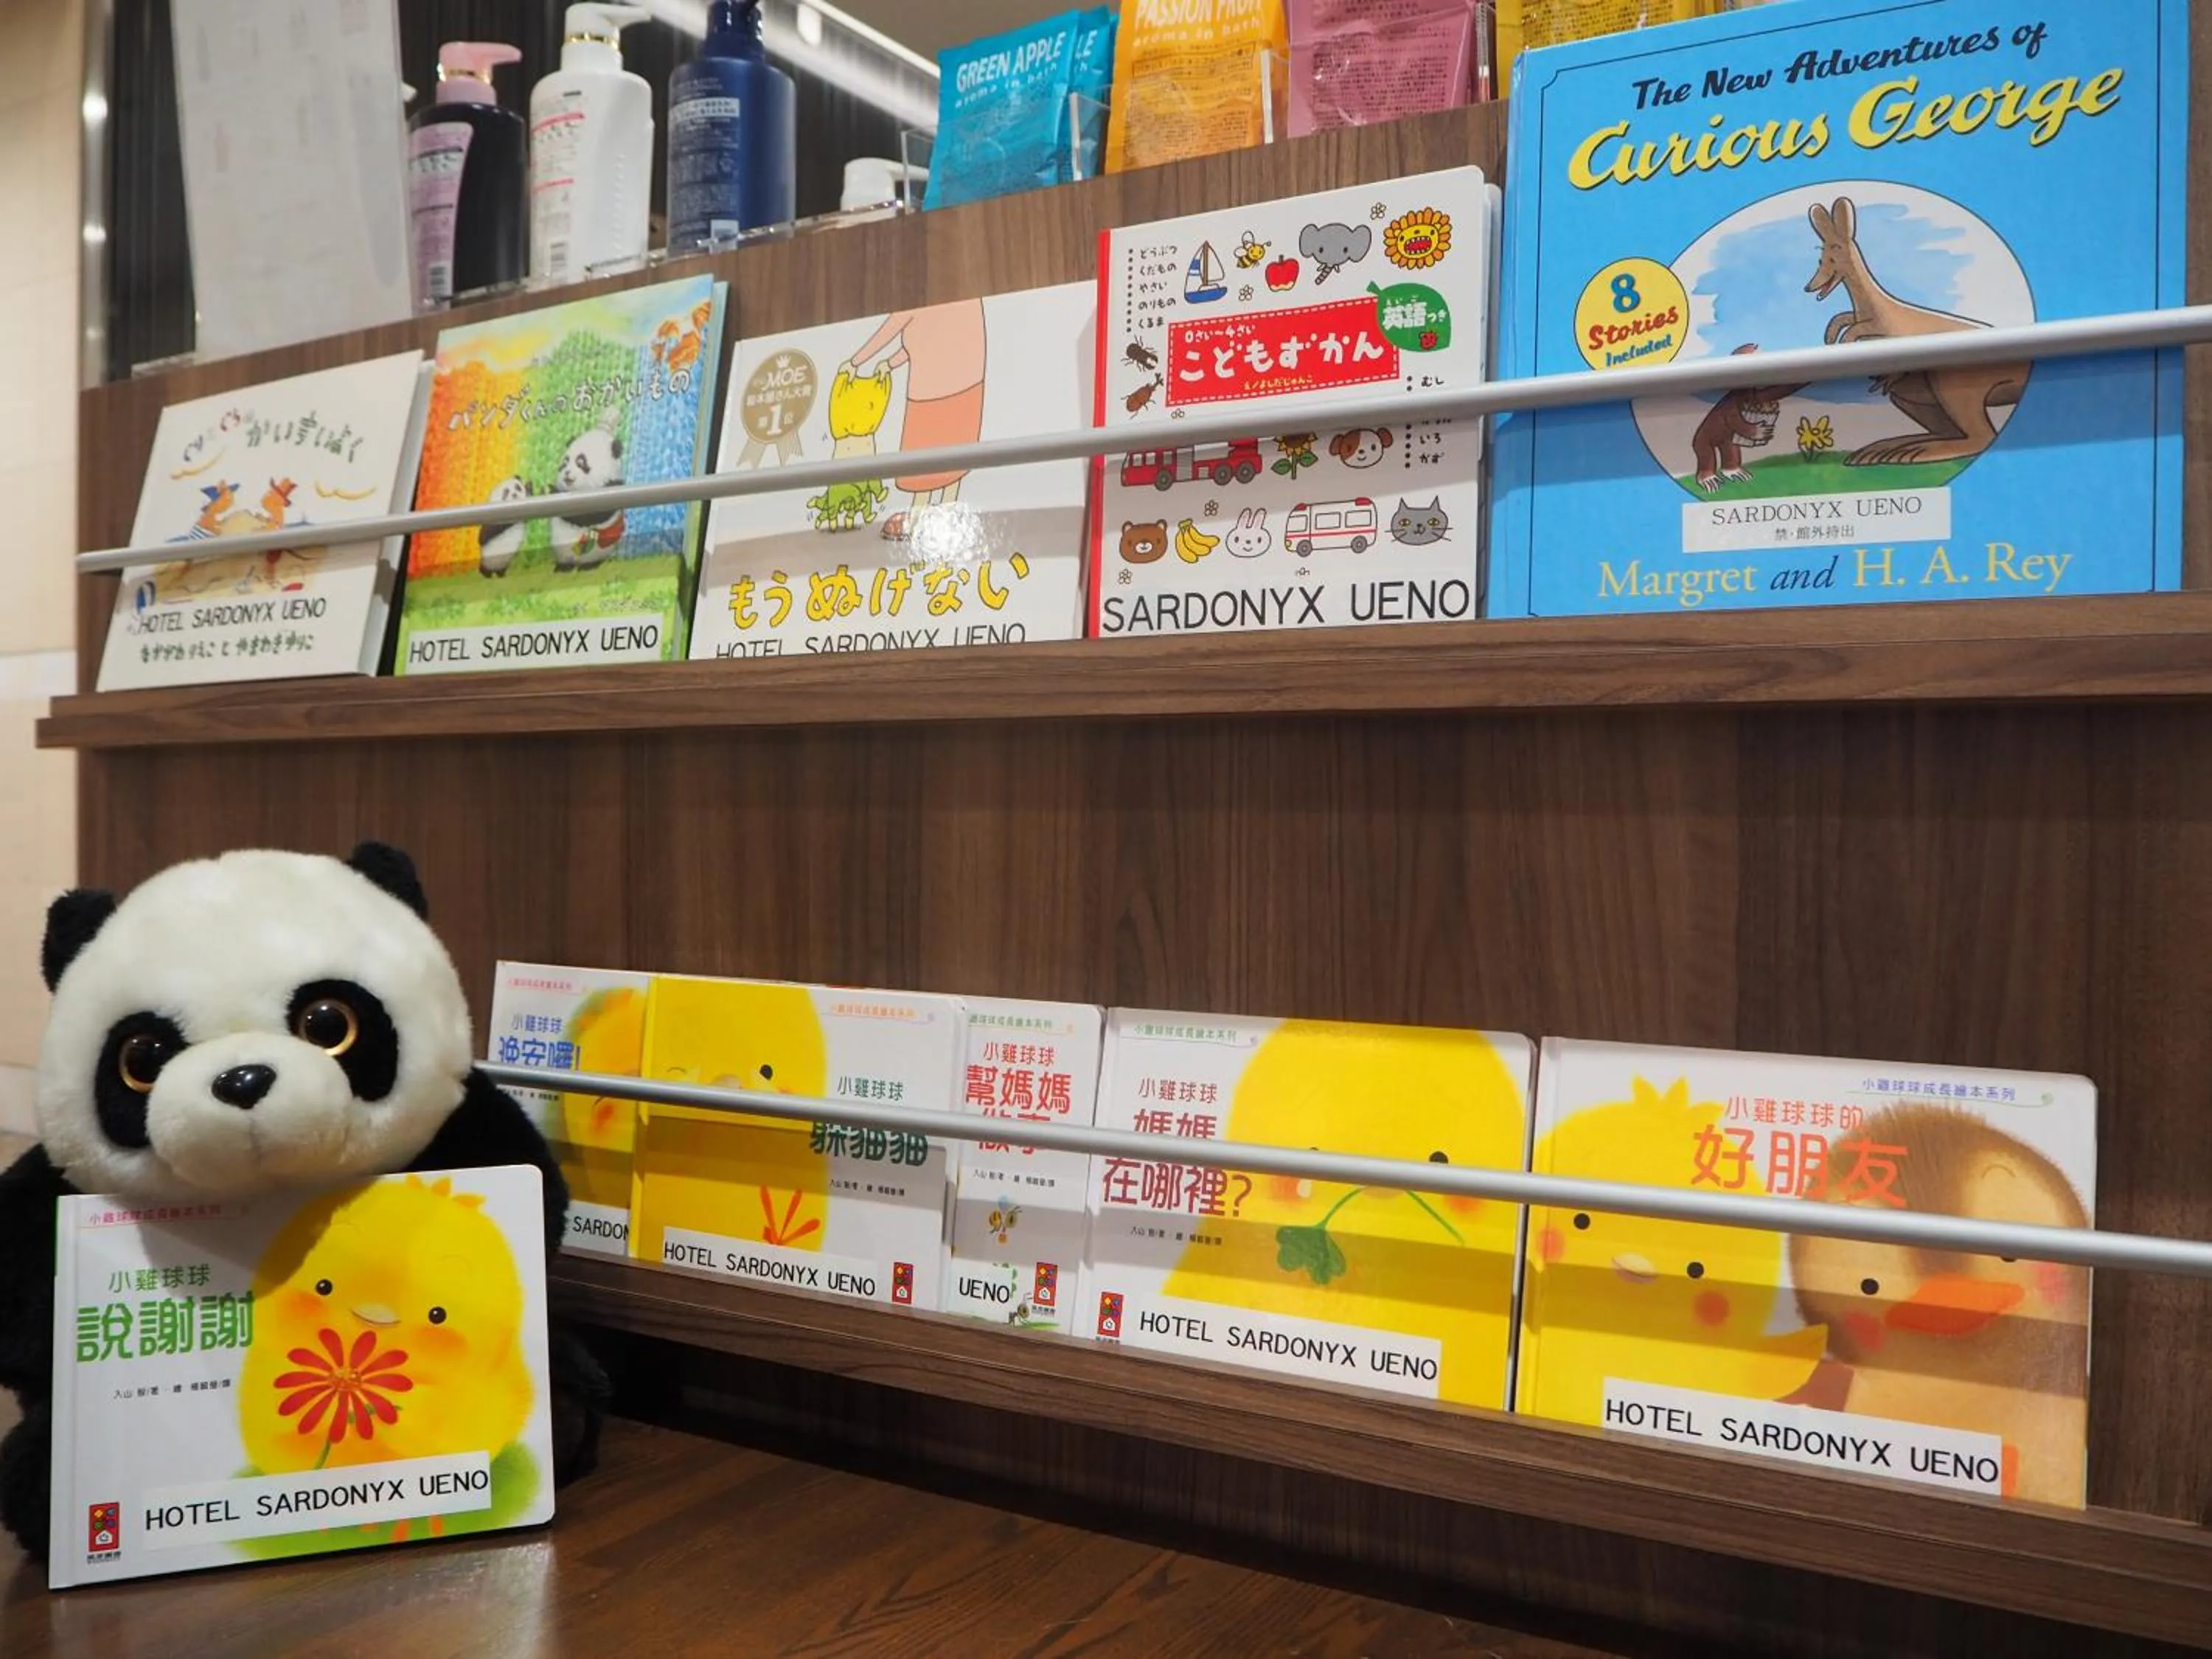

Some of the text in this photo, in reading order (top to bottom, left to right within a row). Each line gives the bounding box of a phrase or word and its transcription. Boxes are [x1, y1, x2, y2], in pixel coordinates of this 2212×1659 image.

[956, 31, 1066, 93] GREEN APPLE
[1632, 22, 2049, 111] The New Adventures of
[1568, 65, 2126, 190] Curious George
[1610, 273, 1641, 313] 8
[1588, 306, 1679, 350] Stories
[1605, 334, 1673, 366] Included
[1180, 331, 1384, 382] こどもずかん
[1422, 376, 1445, 387] むし
[1711, 495, 1923, 526] SARDONYX UENO
[728, 552, 1031, 630] もうぬげない
[1596, 542, 2073, 606] Margret and H. A. Rey
[139, 611, 184, 635] HOTEL
[192, 601, 276, 628] SARDONYX
[281, 597, 327, 619] UENO
[1102, 579, 1470, 633] SARDONYX UENO
[409, 625, 658, 664] HOTEL SARDONYX UENO
[805, 627, 940, 654] SARDONYX
[984, 1041, 1054, 1067] 小雞球球
[837, 1076, 904, 1102] 小雞球球
[966, 1064, 1072, 1114] 幫媽媽
[1138, 1077, 1217, 1104] 小雞球球
[1725, 1096, 1864, 1131] 小雞球球的
[1691, 1124, 1909, 1208] 好朋友
[108, 1264, 211, 1293] 小雞球球
[664, 1241, 876, 1296] HOTEL SARDONYX UENO
[959, 1277, 1010, 1304] UENO
[76, 1290, 254, 1363] 說謝謝
[1139, 1311, 1438, 1380] HOTEL SARDONYX UENO
[1606, 1398, 1999, 1483] HOTEL SARDONYX UENO
[145, 1470, 489, 1531] HOTEL SARDONYX UENO
